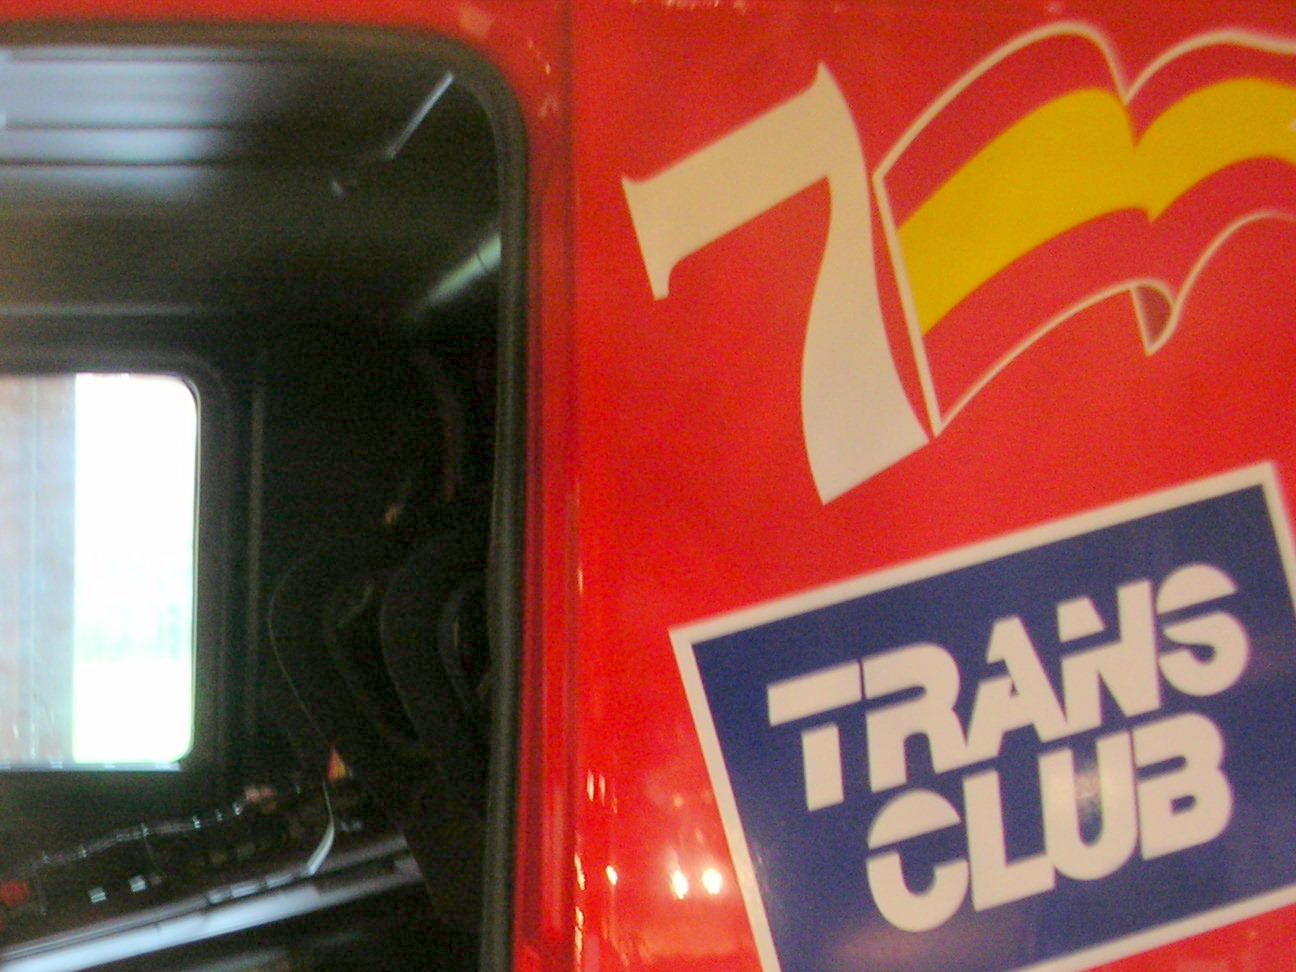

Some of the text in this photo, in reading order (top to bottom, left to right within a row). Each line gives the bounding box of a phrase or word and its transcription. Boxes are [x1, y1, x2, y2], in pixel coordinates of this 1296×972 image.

[622, 62, 929, 505] 7
[767, 564, 1250, 811] TRANS
[867, 712, 1233, 932] CLUB
